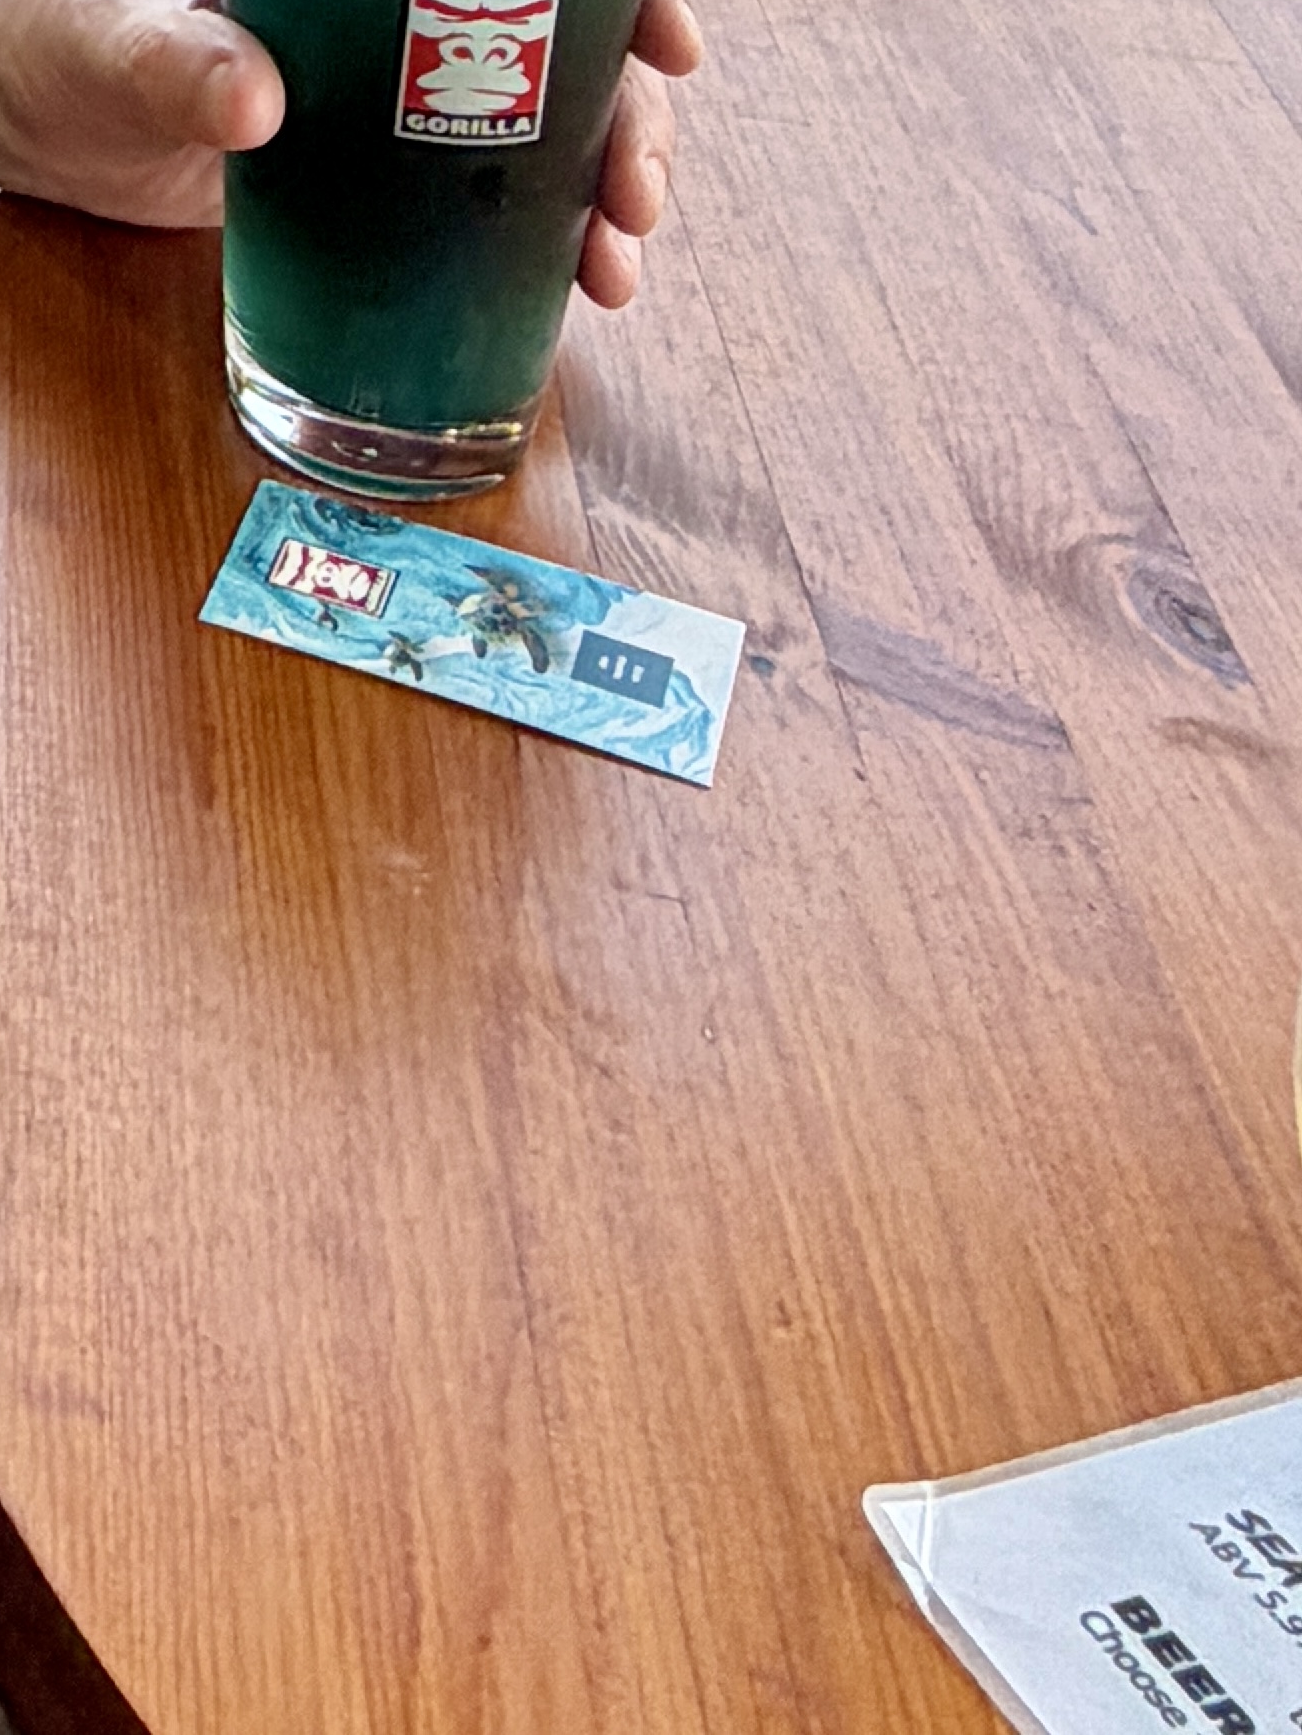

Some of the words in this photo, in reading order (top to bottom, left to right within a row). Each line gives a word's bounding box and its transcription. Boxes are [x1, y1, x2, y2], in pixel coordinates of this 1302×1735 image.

[404, 113, 532, 136] GORILLA
[1188, 1522, 1265, 1581] ABV
[1253, 1590, 1302, 1648] 5.9
[1080, 1610, 1187, 1728] Choose
[1110, 1594, 1255, 1735] BEER
